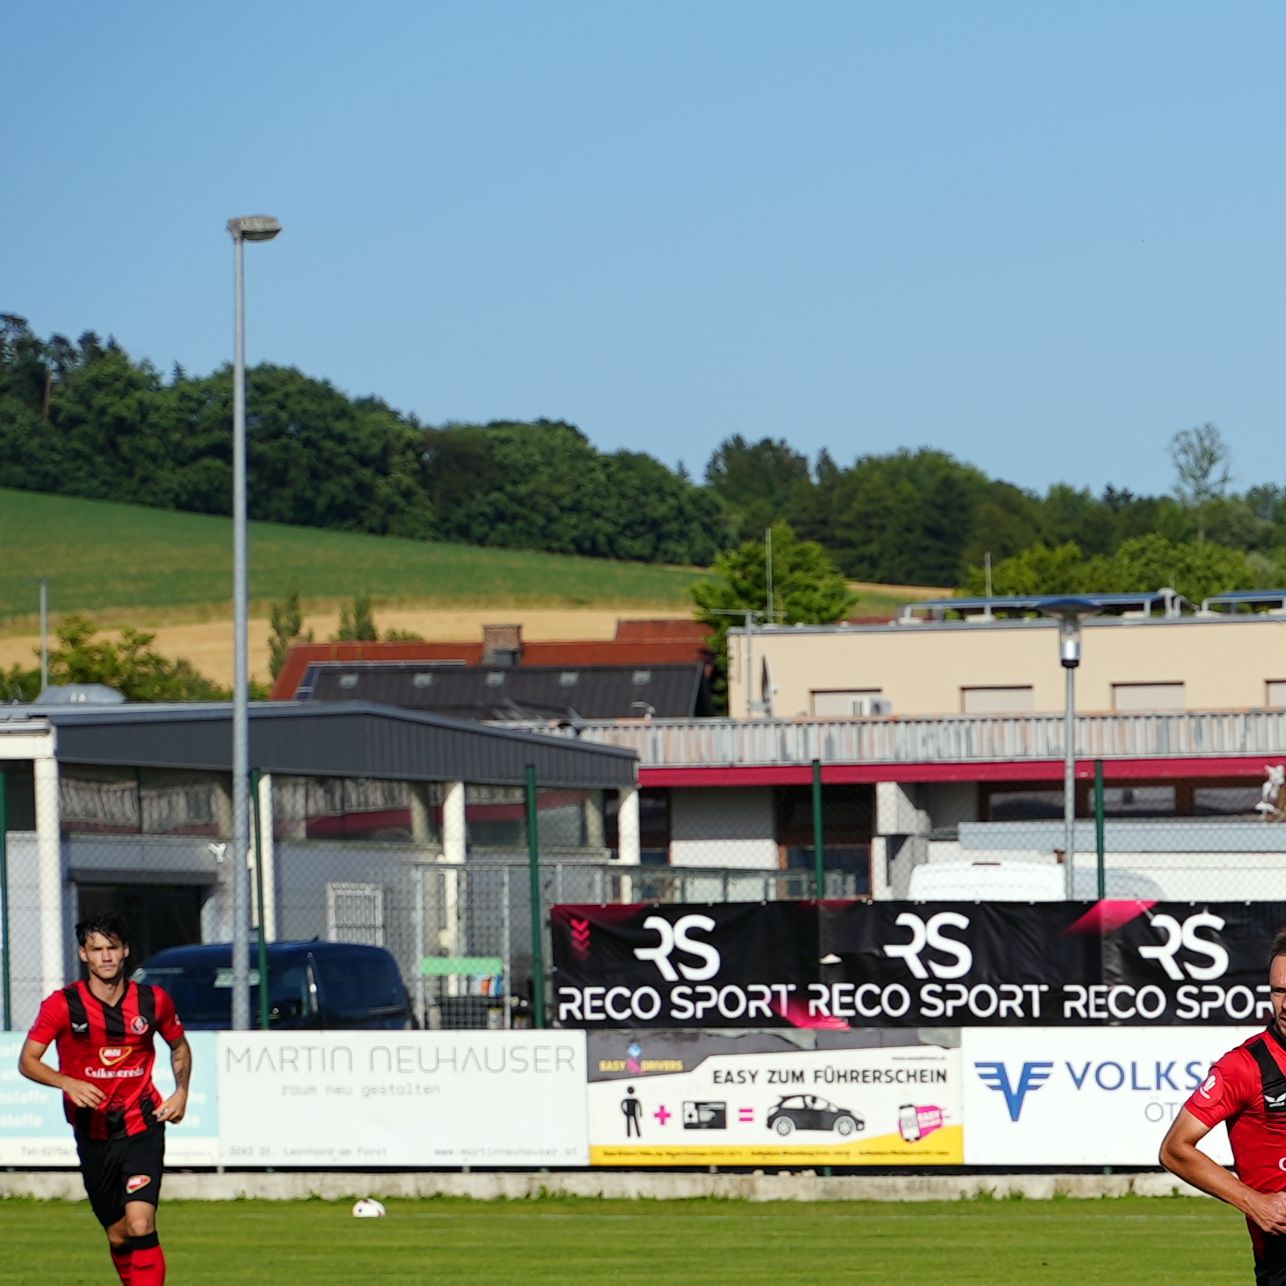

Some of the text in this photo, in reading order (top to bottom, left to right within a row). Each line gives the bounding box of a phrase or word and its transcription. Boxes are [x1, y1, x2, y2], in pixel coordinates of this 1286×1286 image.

[634, 914, 721, 981] RS
[883, 912, 973, 979] RS
[1138, 912, 1230, 981] RS
[558, 984, 796, 1021] RECO SPORT
[808, 983, 1049, 1018] RECO SPORT
[1063, 984, 1274, 1019] RECO SPOR
[226, 1045, 576, 1073] MARTIN NEUHAUSER
[713, 1066, 947, 1084] EASY ZUM FÜHRERSCHEIN
[1065, 1061, 1208, 1091] VOLKS
[325, 1084, 353, 1096] neu
